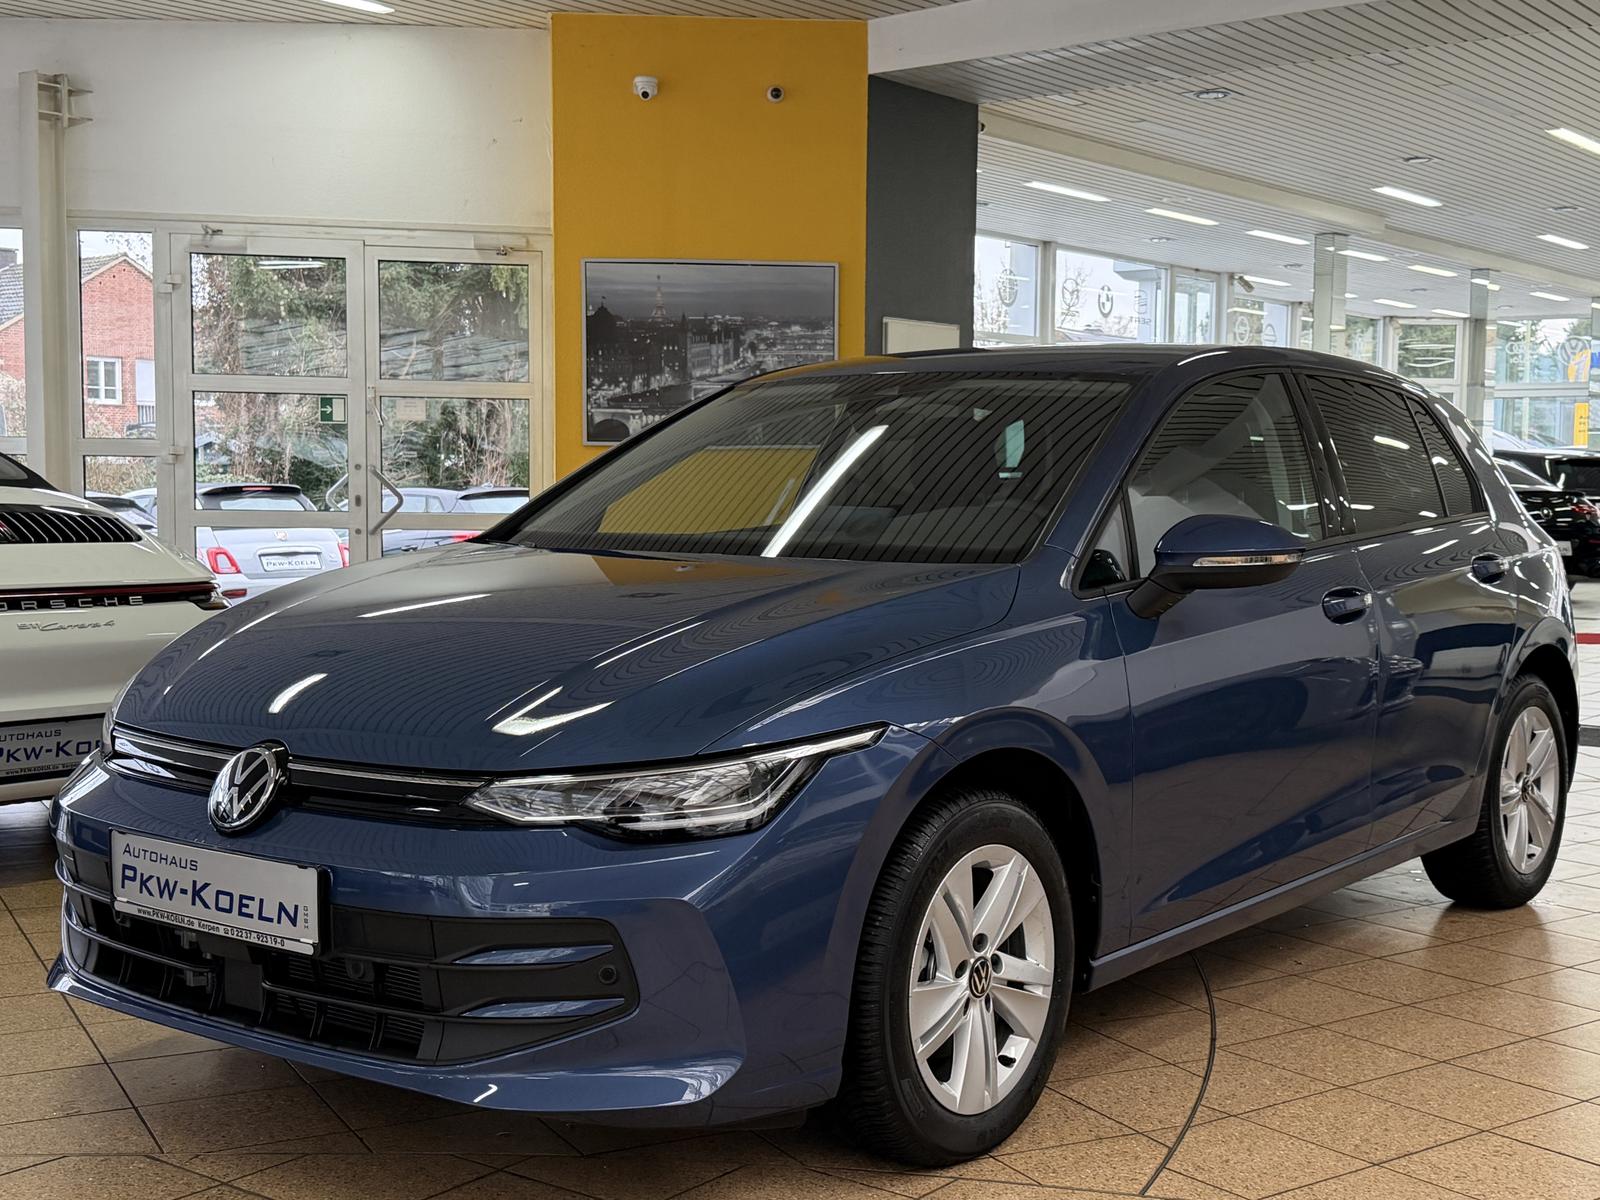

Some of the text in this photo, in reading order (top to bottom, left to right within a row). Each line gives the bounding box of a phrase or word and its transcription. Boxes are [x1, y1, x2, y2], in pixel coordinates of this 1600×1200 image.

[122, 843, 199, 872] AUTOHAUS
[121, 863, 299, 928] PKW-KOELN
[198, 920, 220, 933] Kerpen
